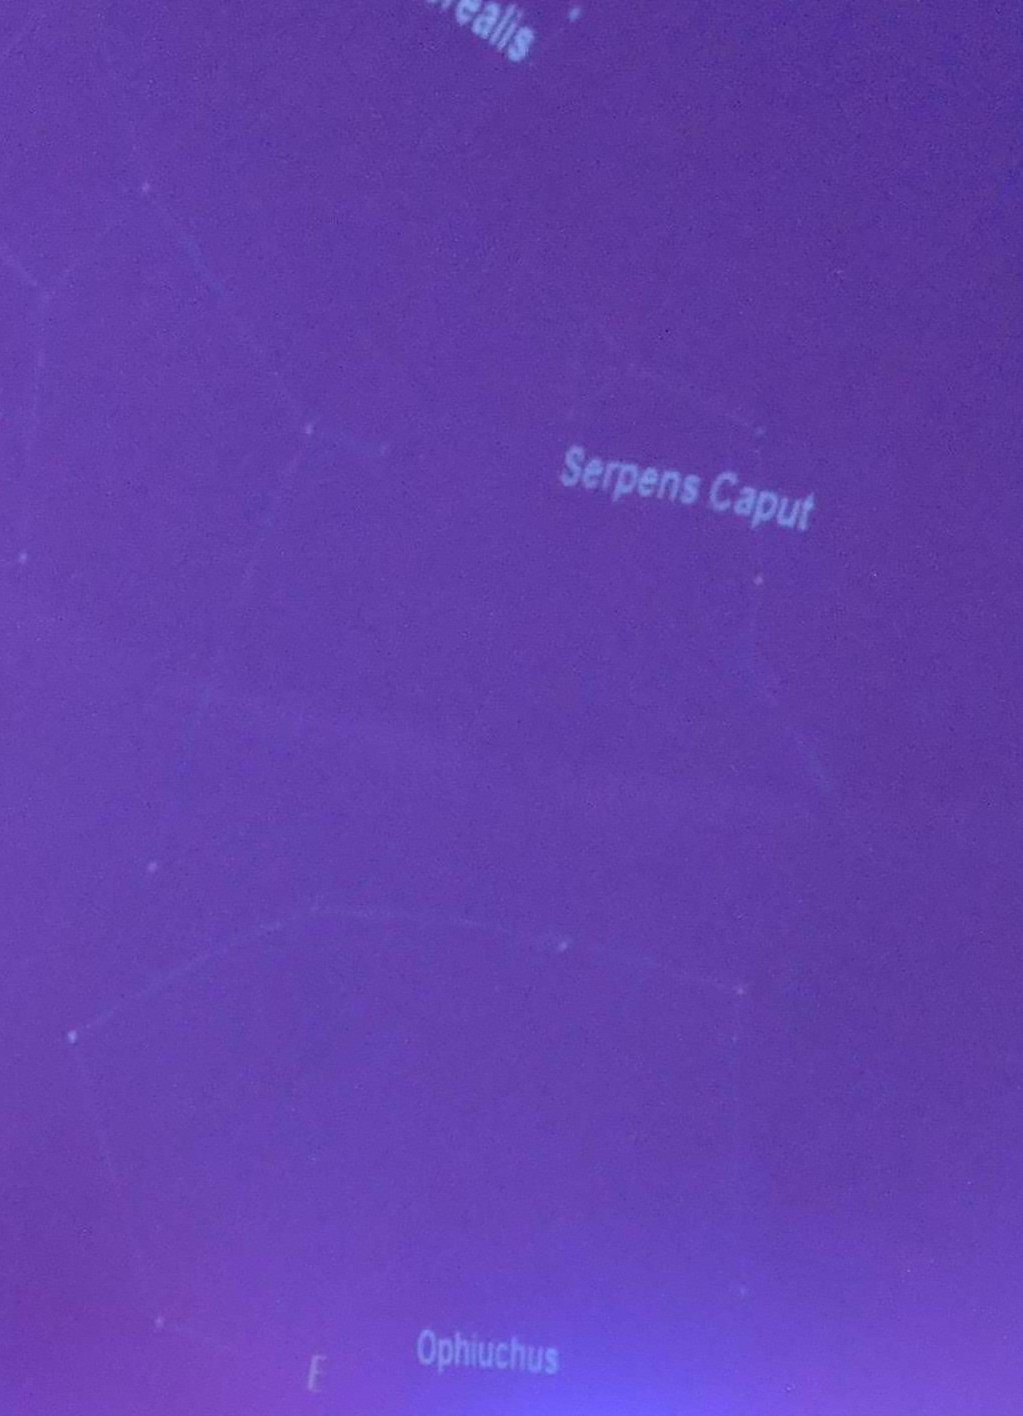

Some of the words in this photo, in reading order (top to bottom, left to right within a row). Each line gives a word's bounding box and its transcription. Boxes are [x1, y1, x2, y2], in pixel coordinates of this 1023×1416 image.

[560, 445, 701, 503] Serpens
[708, 471, 815, 530] Caput
[416, 1328, 560, 1375] Ophiuchus
